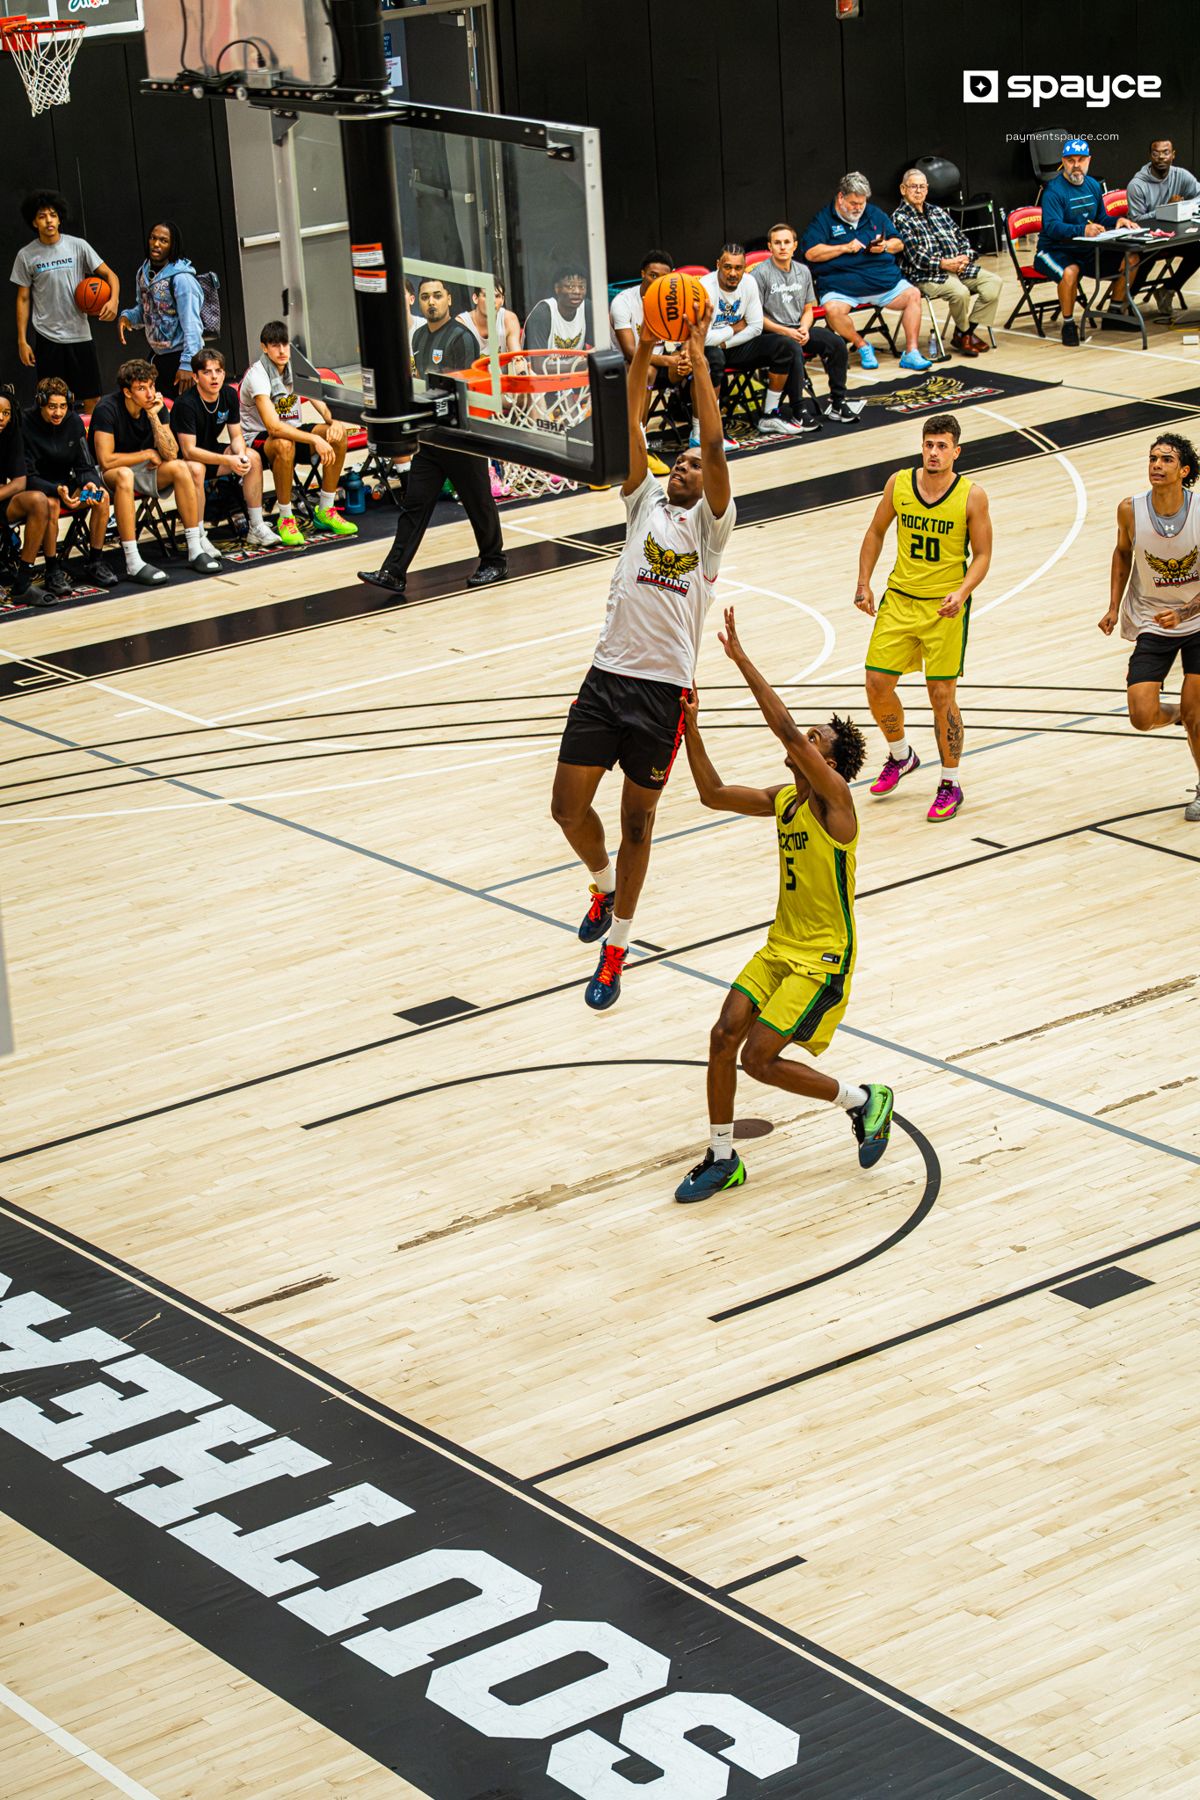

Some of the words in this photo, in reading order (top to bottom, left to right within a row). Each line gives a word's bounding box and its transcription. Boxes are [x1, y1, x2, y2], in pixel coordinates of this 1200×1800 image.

[665, 277, 680, 322] Wilson
[901, 513, 954, 535] ROCKTOP
[910, 533, 940, 562] 20
[637, 568, 690, 595] FALCONS
[785, 857, 797, 891] 5
[0, 1272, 800, 1800] SOUTHEA
